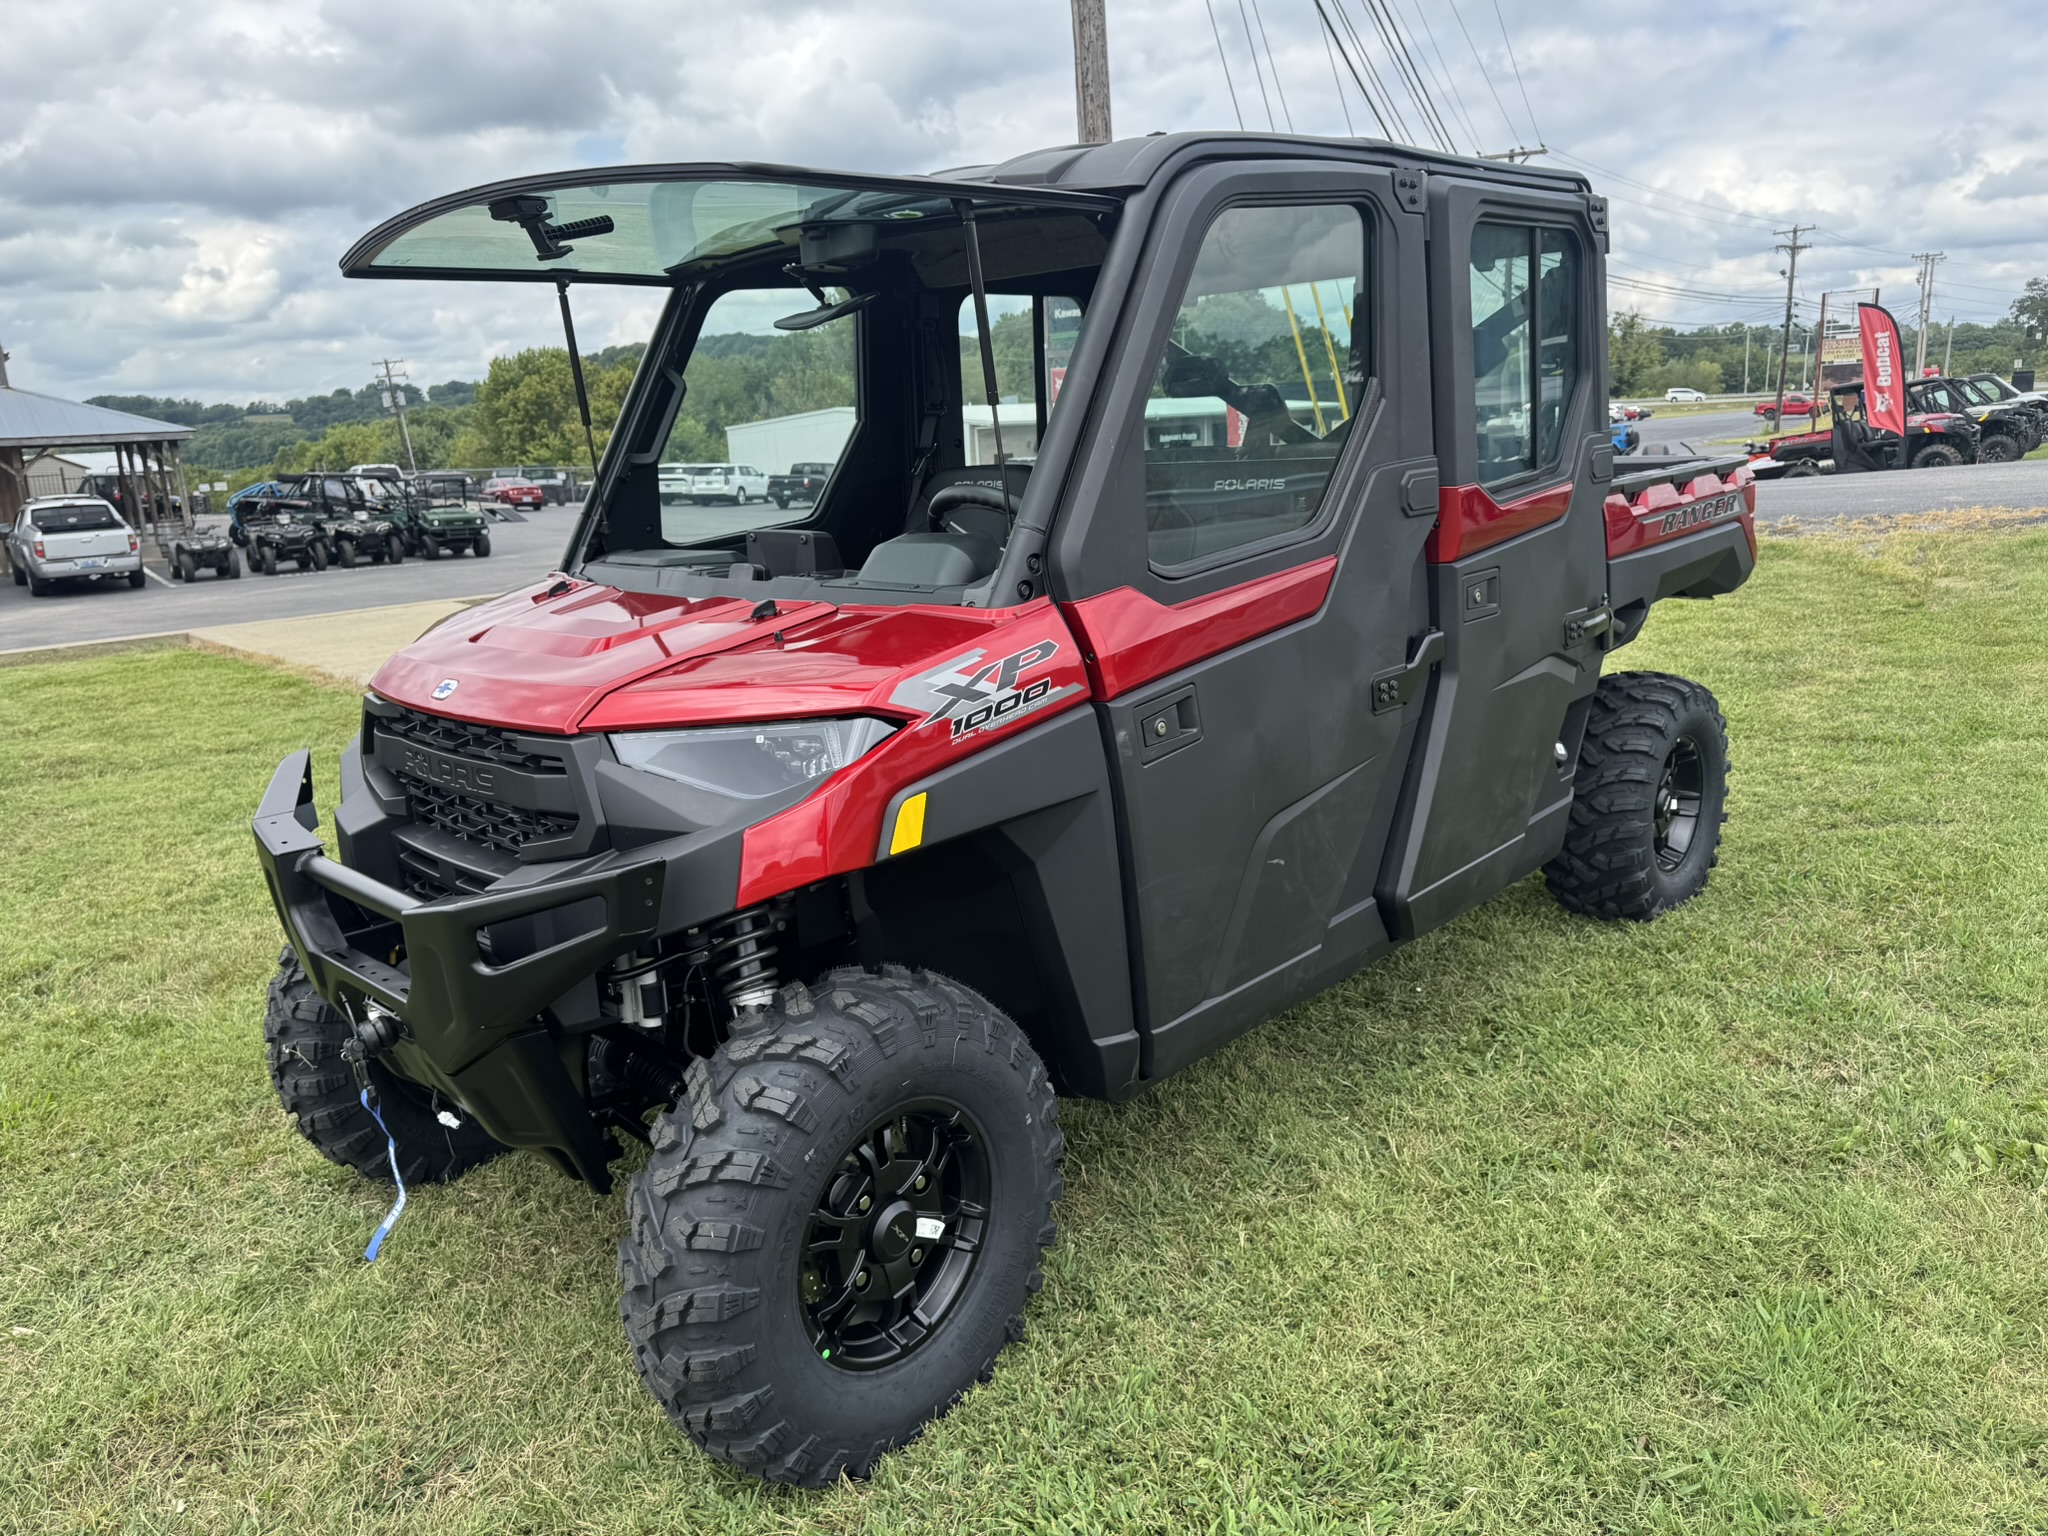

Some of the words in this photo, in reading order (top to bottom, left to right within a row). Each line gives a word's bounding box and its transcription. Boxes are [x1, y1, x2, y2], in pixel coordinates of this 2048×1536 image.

[1054, 308, 1081, 319] Kawas
[1874, 330, 1891, 387] Bobcat
[1213, 478, 1286, 491] POLARIS
[1660, 494, 1736, 534] RANGER
[913, 638, 1060, 733] XP
[950, 676, 1052, 740] 1000
[952, 731, 977, 746] DUAL
[978, 707, 1027, 733] OVERHEAD
[1028, 697, 1048, 710] CAM
[404, 748, 495, 796] POLARIS
